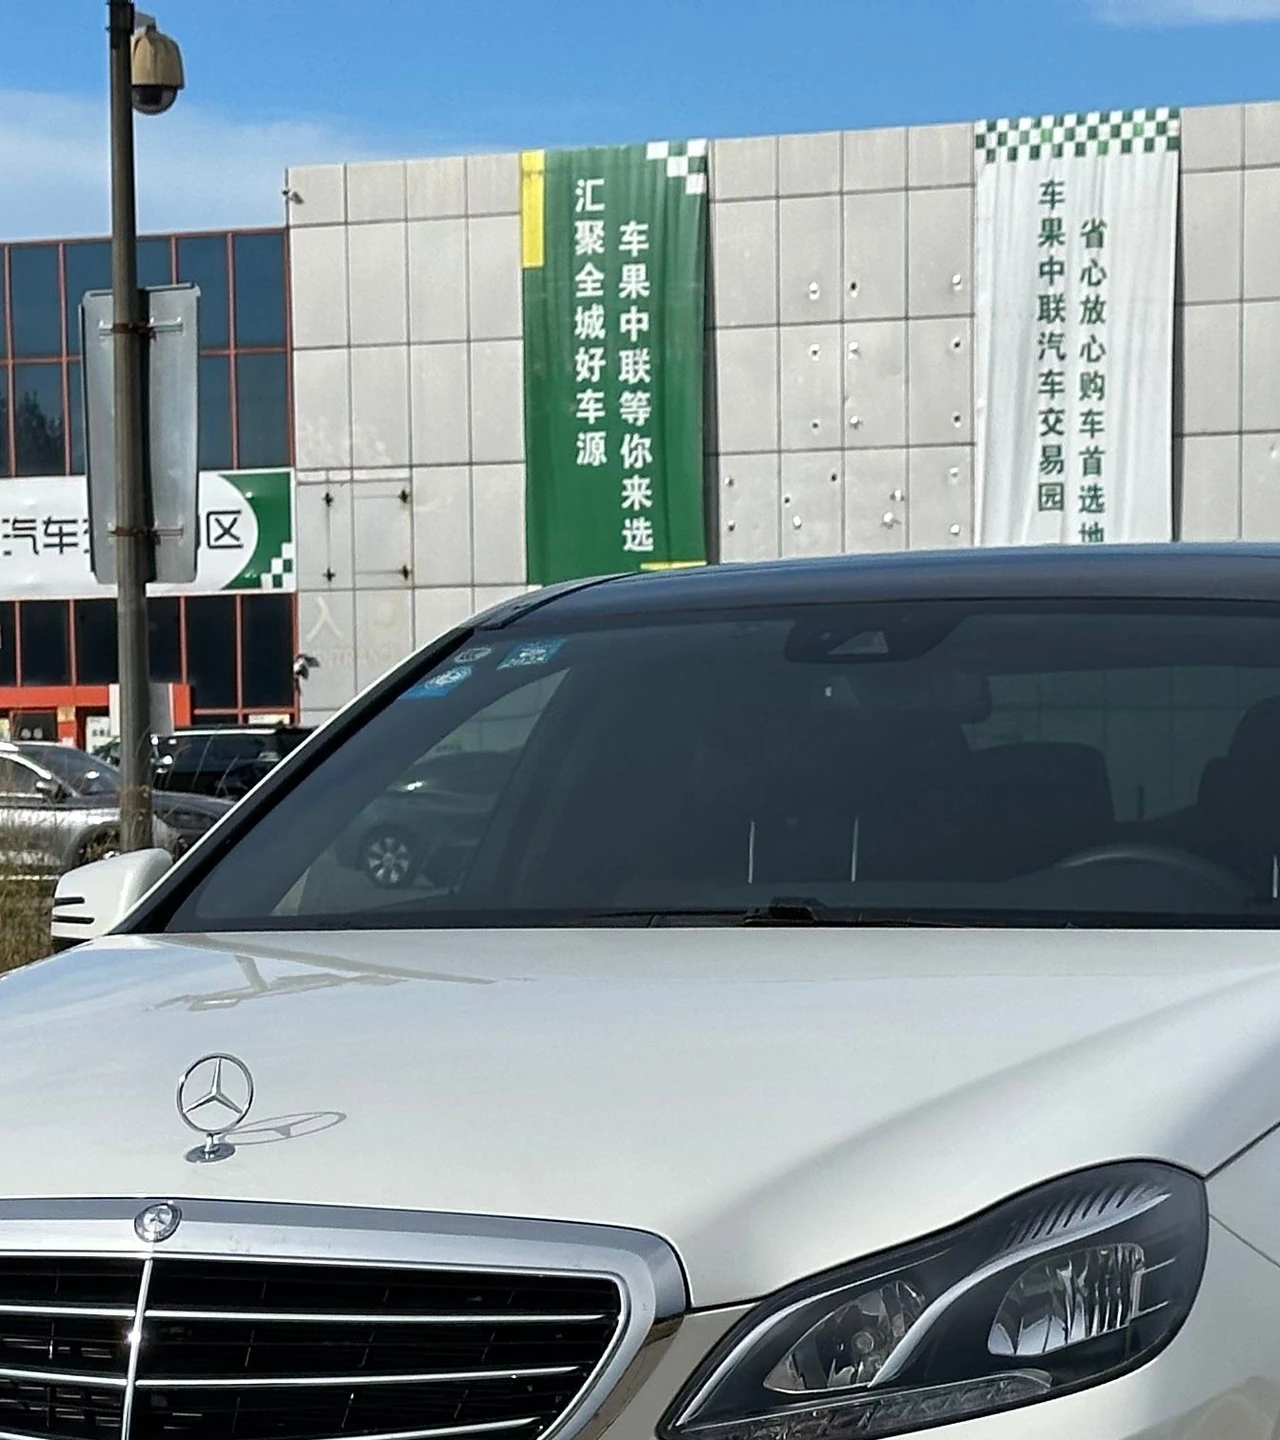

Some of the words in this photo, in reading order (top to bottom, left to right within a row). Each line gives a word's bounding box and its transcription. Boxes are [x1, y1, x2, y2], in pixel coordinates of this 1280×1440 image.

[574, 179, 607, 467] 汇聚全城好车源
[618, 220, 655, 552] 车果中联等你来选
[1037, 180, 1067, 512] 车果中联汽车交易园
[1078, 218, 1107, 542] 省心放心购车首选地
